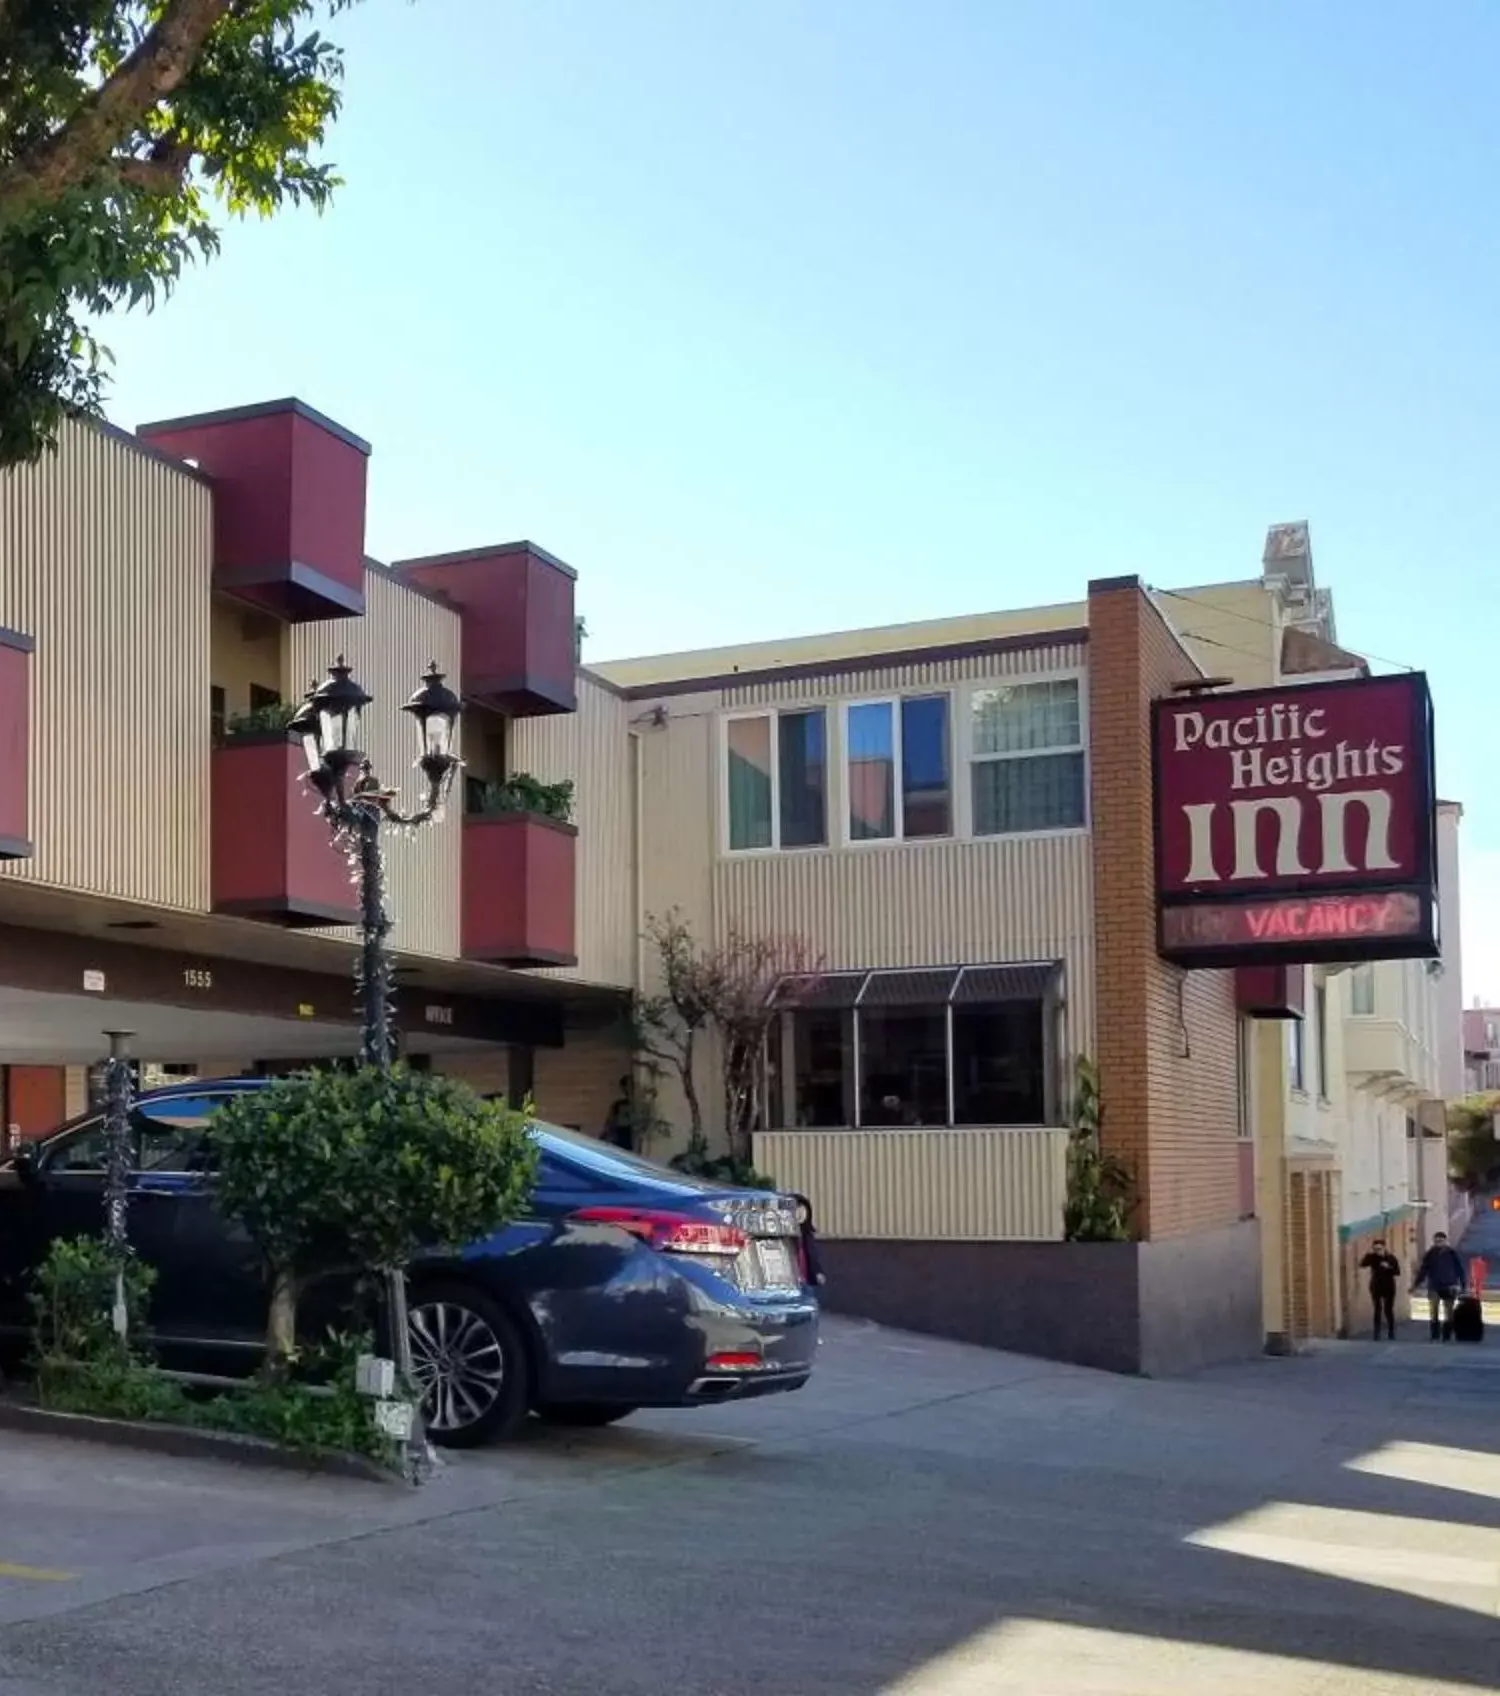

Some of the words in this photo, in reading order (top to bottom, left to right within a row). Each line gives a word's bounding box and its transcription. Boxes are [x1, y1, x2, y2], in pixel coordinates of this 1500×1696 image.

[1174, 703, 1326, 751] Pacific
[1230, 738, 1405, 790] Heights
[1245, 900, 1392, 937] VACANCY
